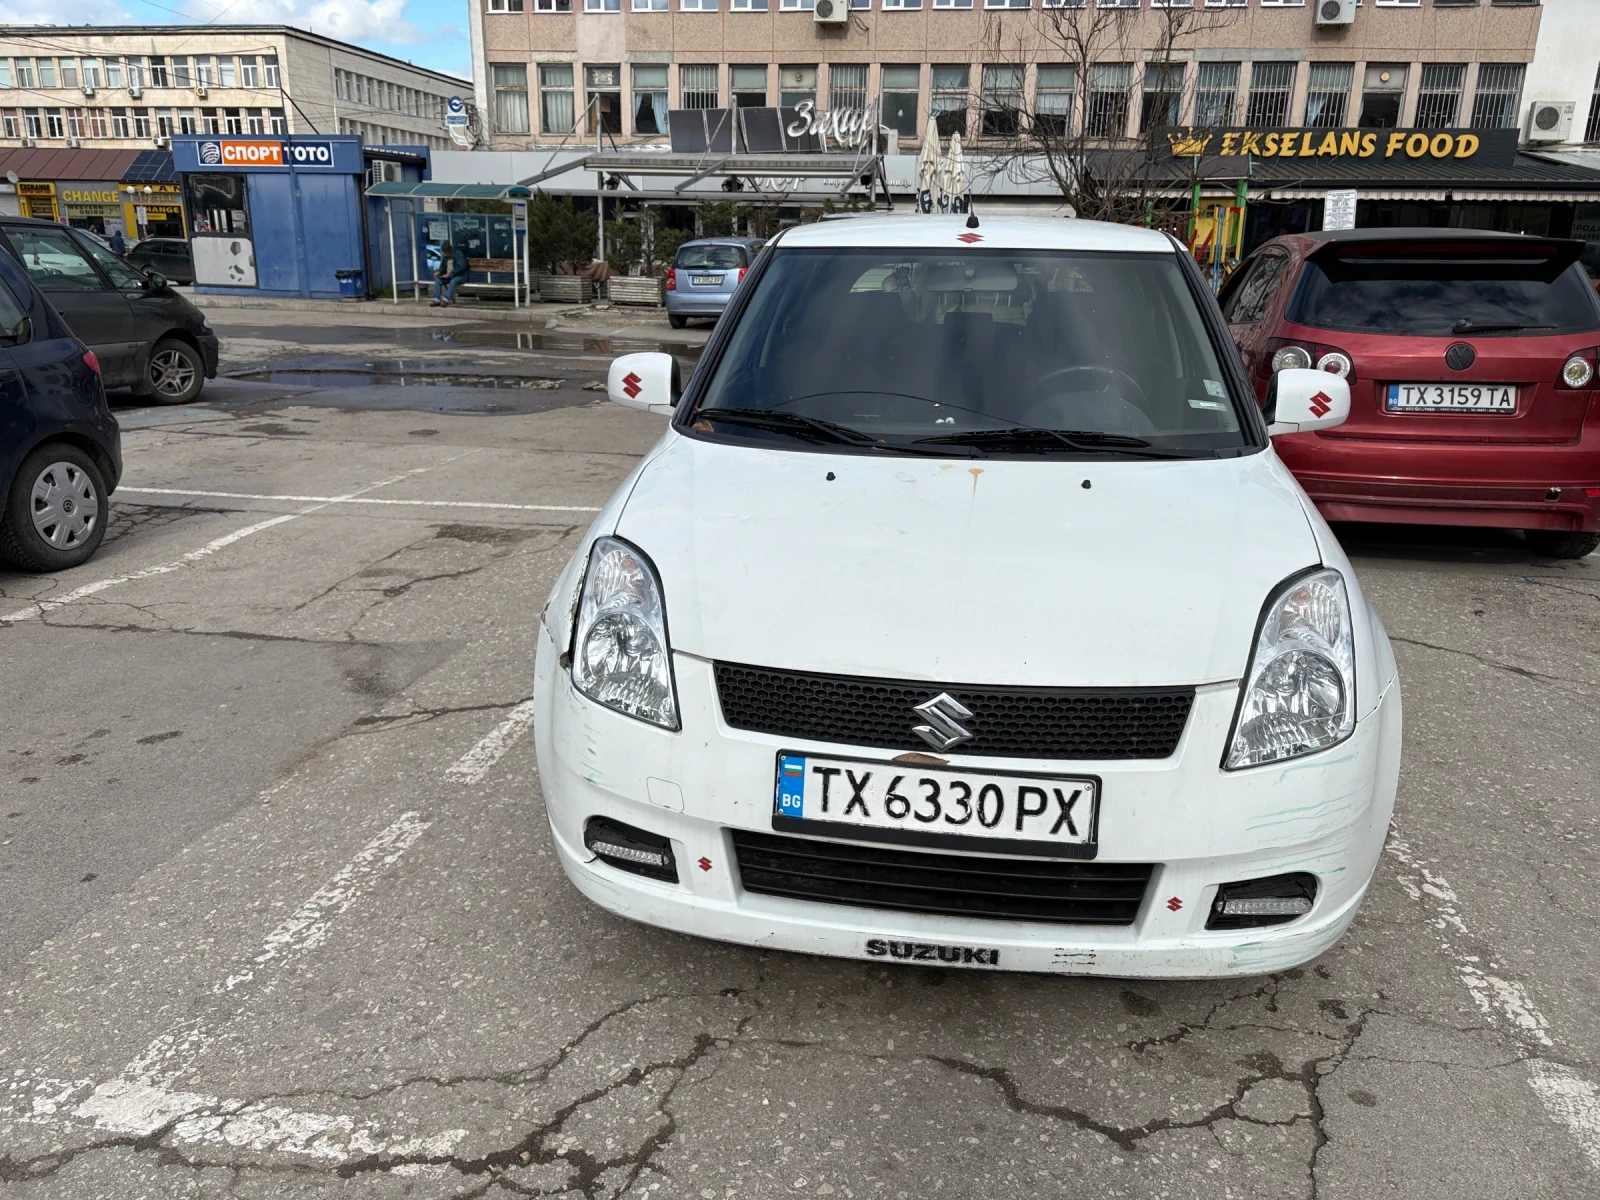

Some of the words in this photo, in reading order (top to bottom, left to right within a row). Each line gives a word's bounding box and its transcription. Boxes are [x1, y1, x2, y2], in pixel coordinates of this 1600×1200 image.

[223, 145, 280, 161] СПОРТ
[283, 146, 329, 162] ТОТО
[1219, 132, 1377, 157] EKSELANS
[1385, 134, 1480, 158] FOOD
[62, 190, 119, 203] CHANGE
[145, 206, 180, 214] HANGE
[1402, 386, 1429, 405] TX
[1432, 387, 1482, 406] 3159
[1487, 388, 1511, 407] TA
[782, 793, 801, 808] BG
[812, 766, 873, 817] TX
[883, 775, 1005, 829] 6330
[1014, 785, 1082, 836] PX
[865, 938, 1001, 966] SUZUKI
